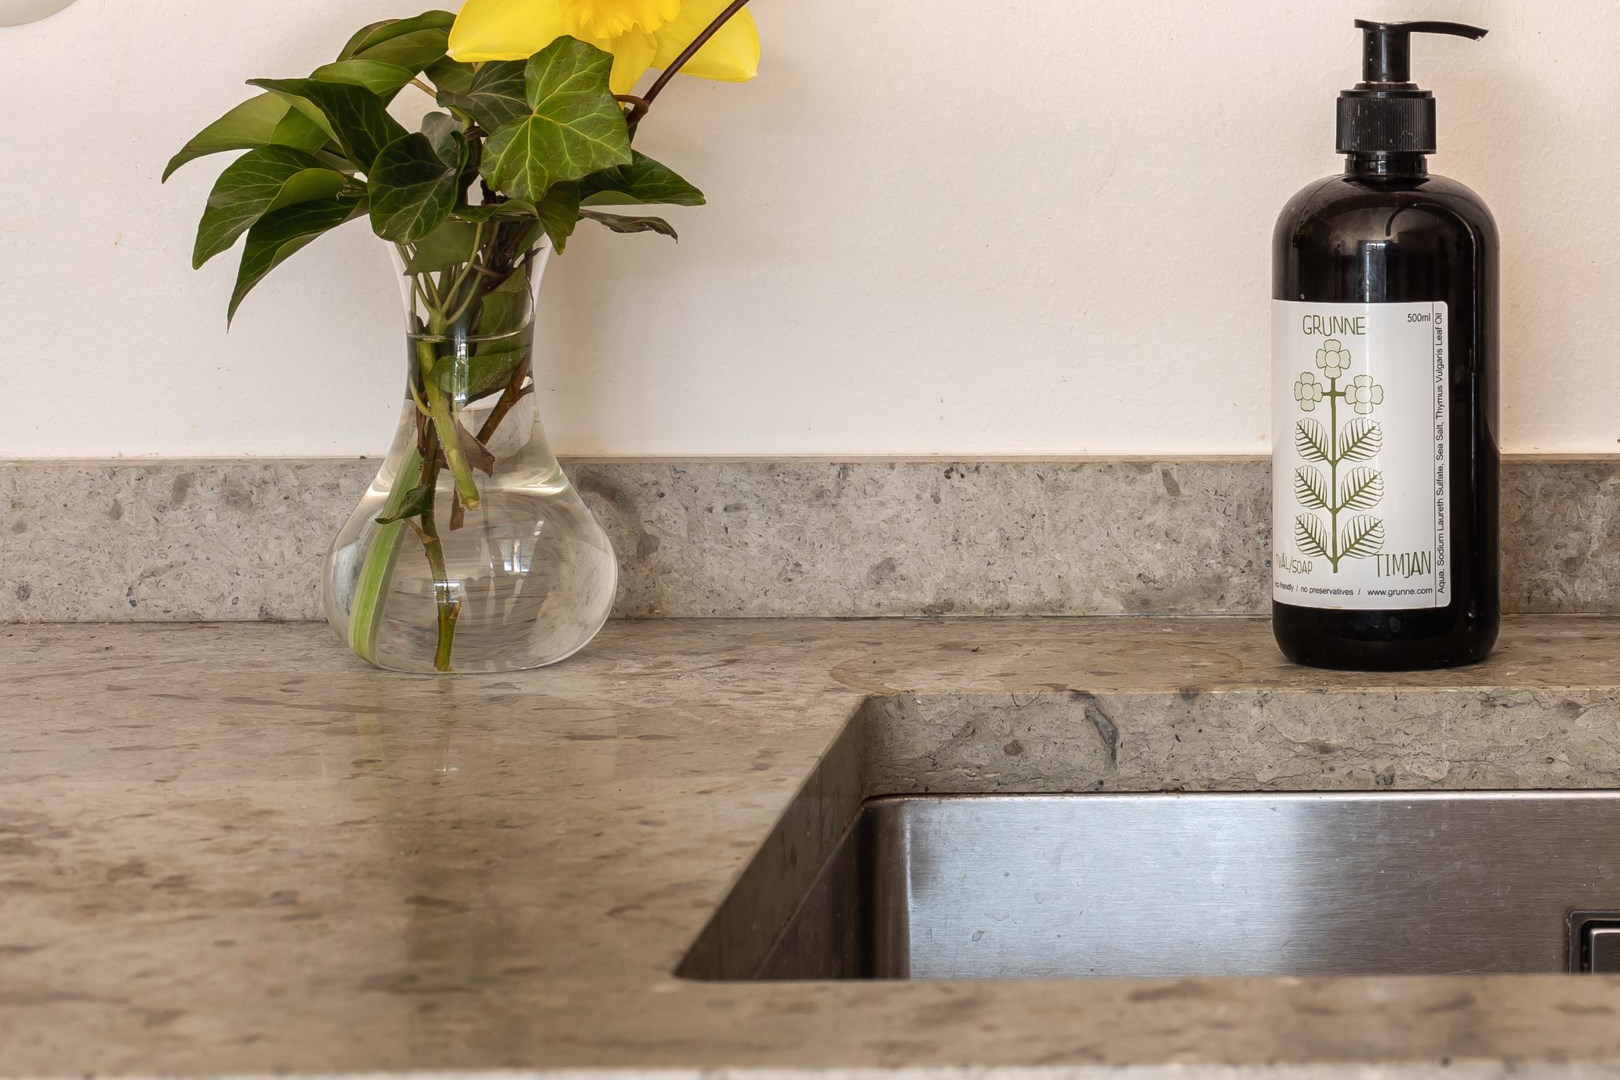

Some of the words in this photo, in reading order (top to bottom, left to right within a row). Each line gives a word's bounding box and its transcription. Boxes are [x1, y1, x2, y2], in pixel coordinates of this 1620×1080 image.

[1302, 314, 1366, 337] GRUNNE
[1407, 312, 1431, 323] 500ml
[1435, 312, 1443, 325] Oil
[1435, 327, 1443, 346] Leaf
[1435, 348, 1444, 383] Vulgaris
[1435, 384, 1445, 420] Thymus
[1436, 421, 1444, 441] Salt,
[1436, 443, 1444, 461] Sea
[1436, 463, 1445, 496] Sulfate,
[1436, 498, 1444, 532] Laureth
[1437, 533, 1445, 567] Sodium
[1376, 550, 1432, 579] TIMJAN
[1309, 587, 1354, 596] preservatives
[1367, 587, 1433, 597] www.grunne.com
[1437, 568, 1446, 594] Aqua,
